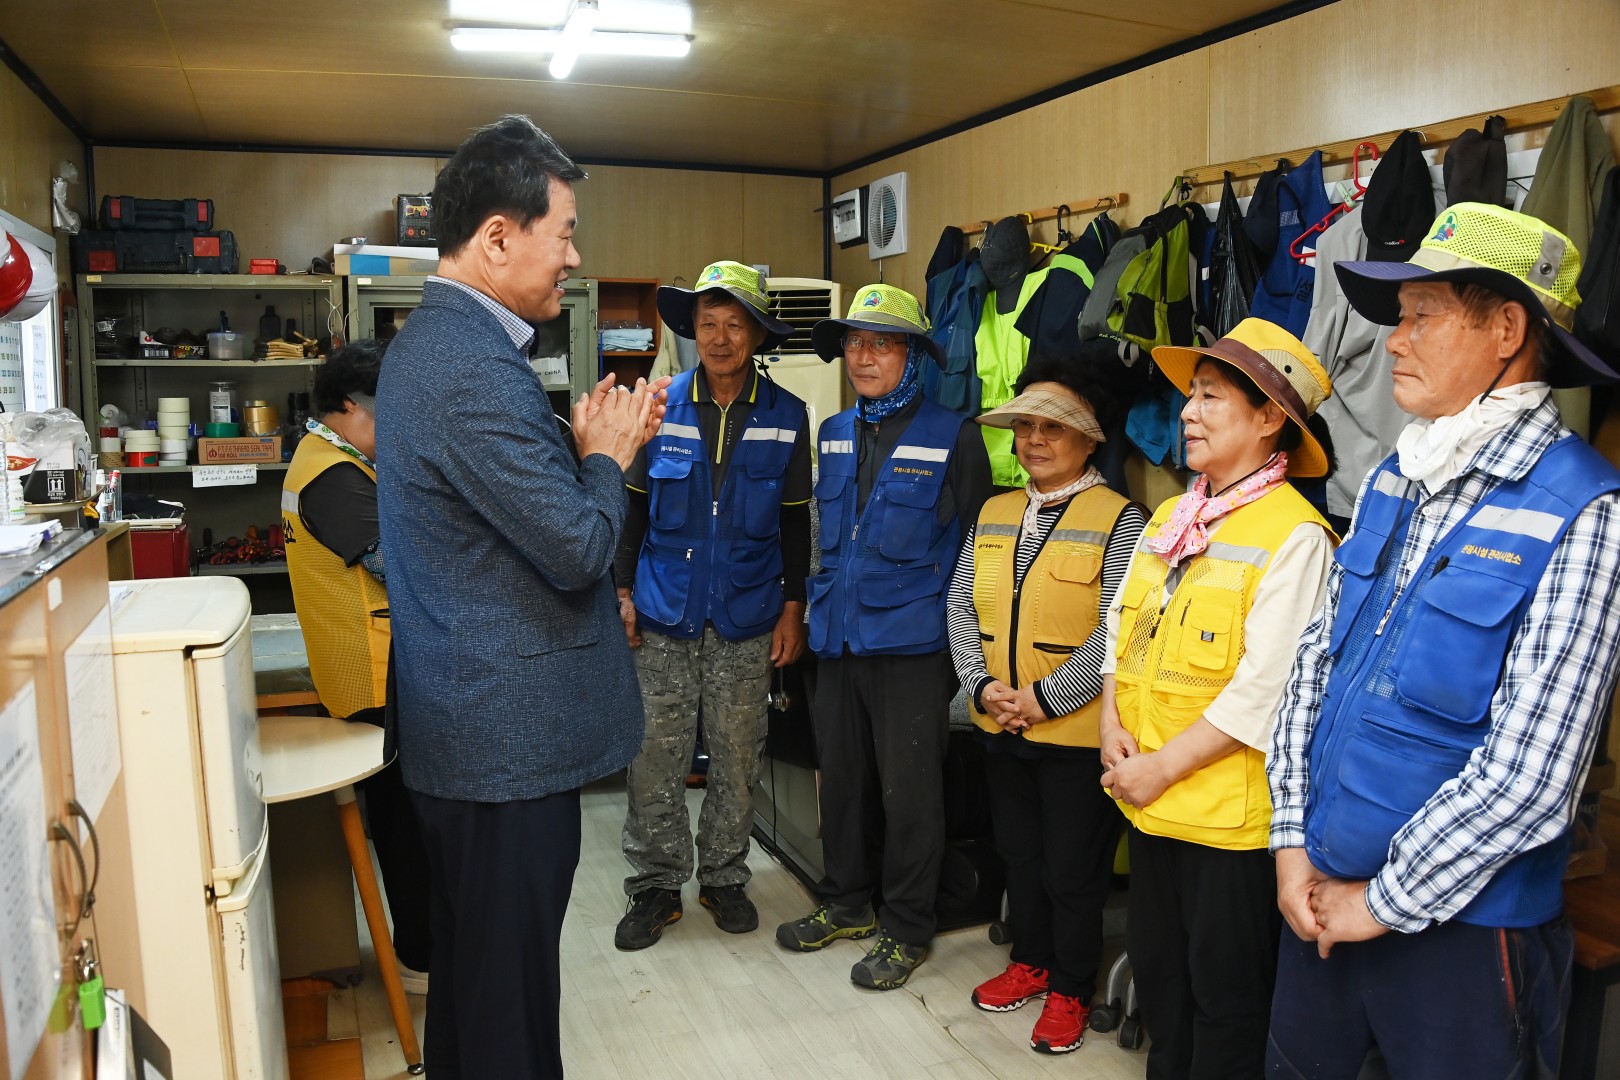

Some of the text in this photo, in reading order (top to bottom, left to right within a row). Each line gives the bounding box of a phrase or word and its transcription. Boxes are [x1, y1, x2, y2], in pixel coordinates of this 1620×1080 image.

[250, 444, 260, 452] SEAL
[261, 443, 273, 452] TAPE
[1487, 549, 1522, 566] 관리사업소
